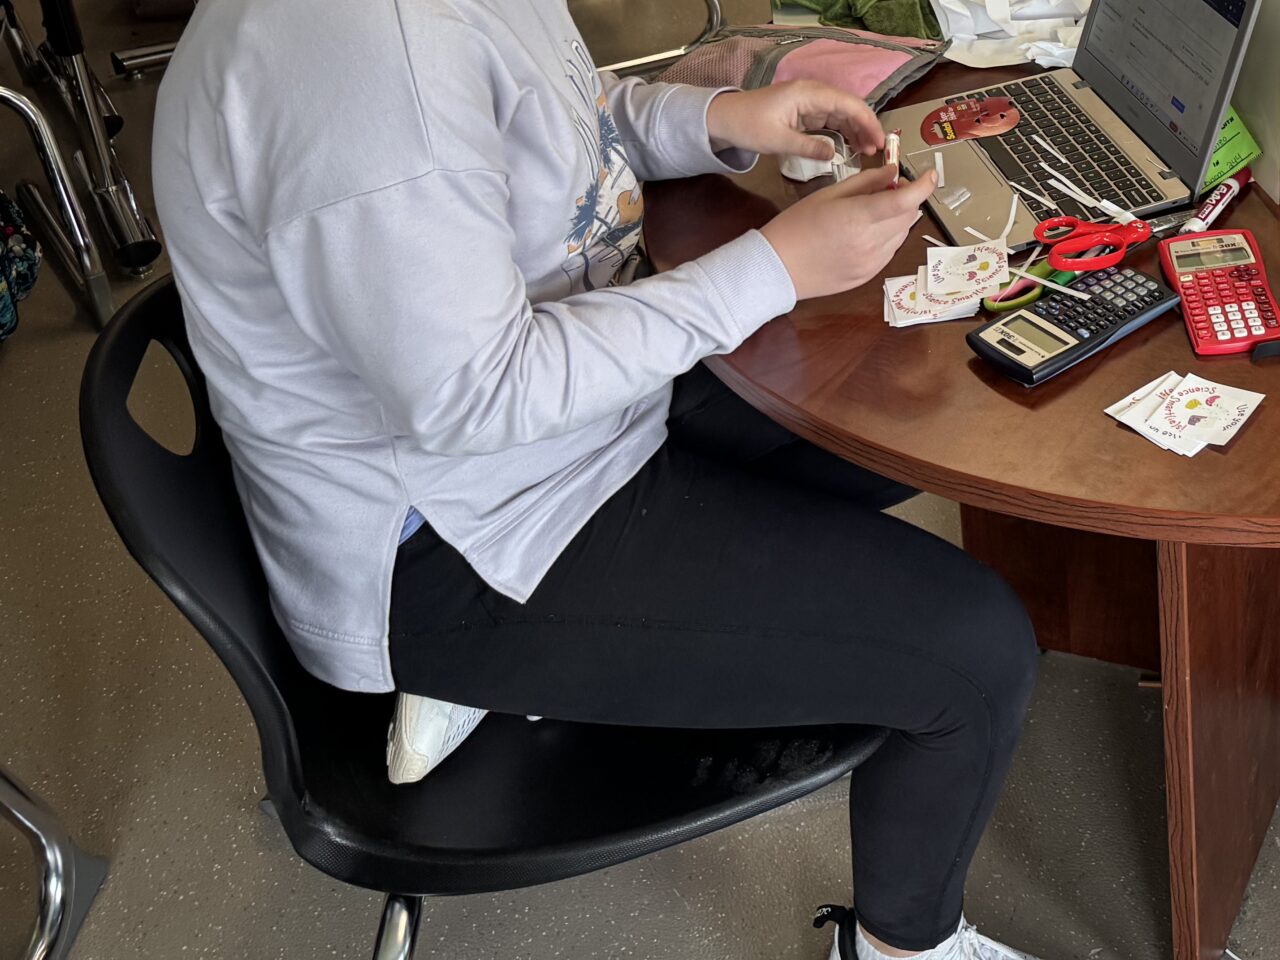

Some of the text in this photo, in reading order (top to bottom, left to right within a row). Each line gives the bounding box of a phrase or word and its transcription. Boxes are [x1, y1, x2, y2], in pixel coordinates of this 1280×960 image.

[1179, 386, 1217, 397] Science
[1221, 403, 1249, 432] Use your
